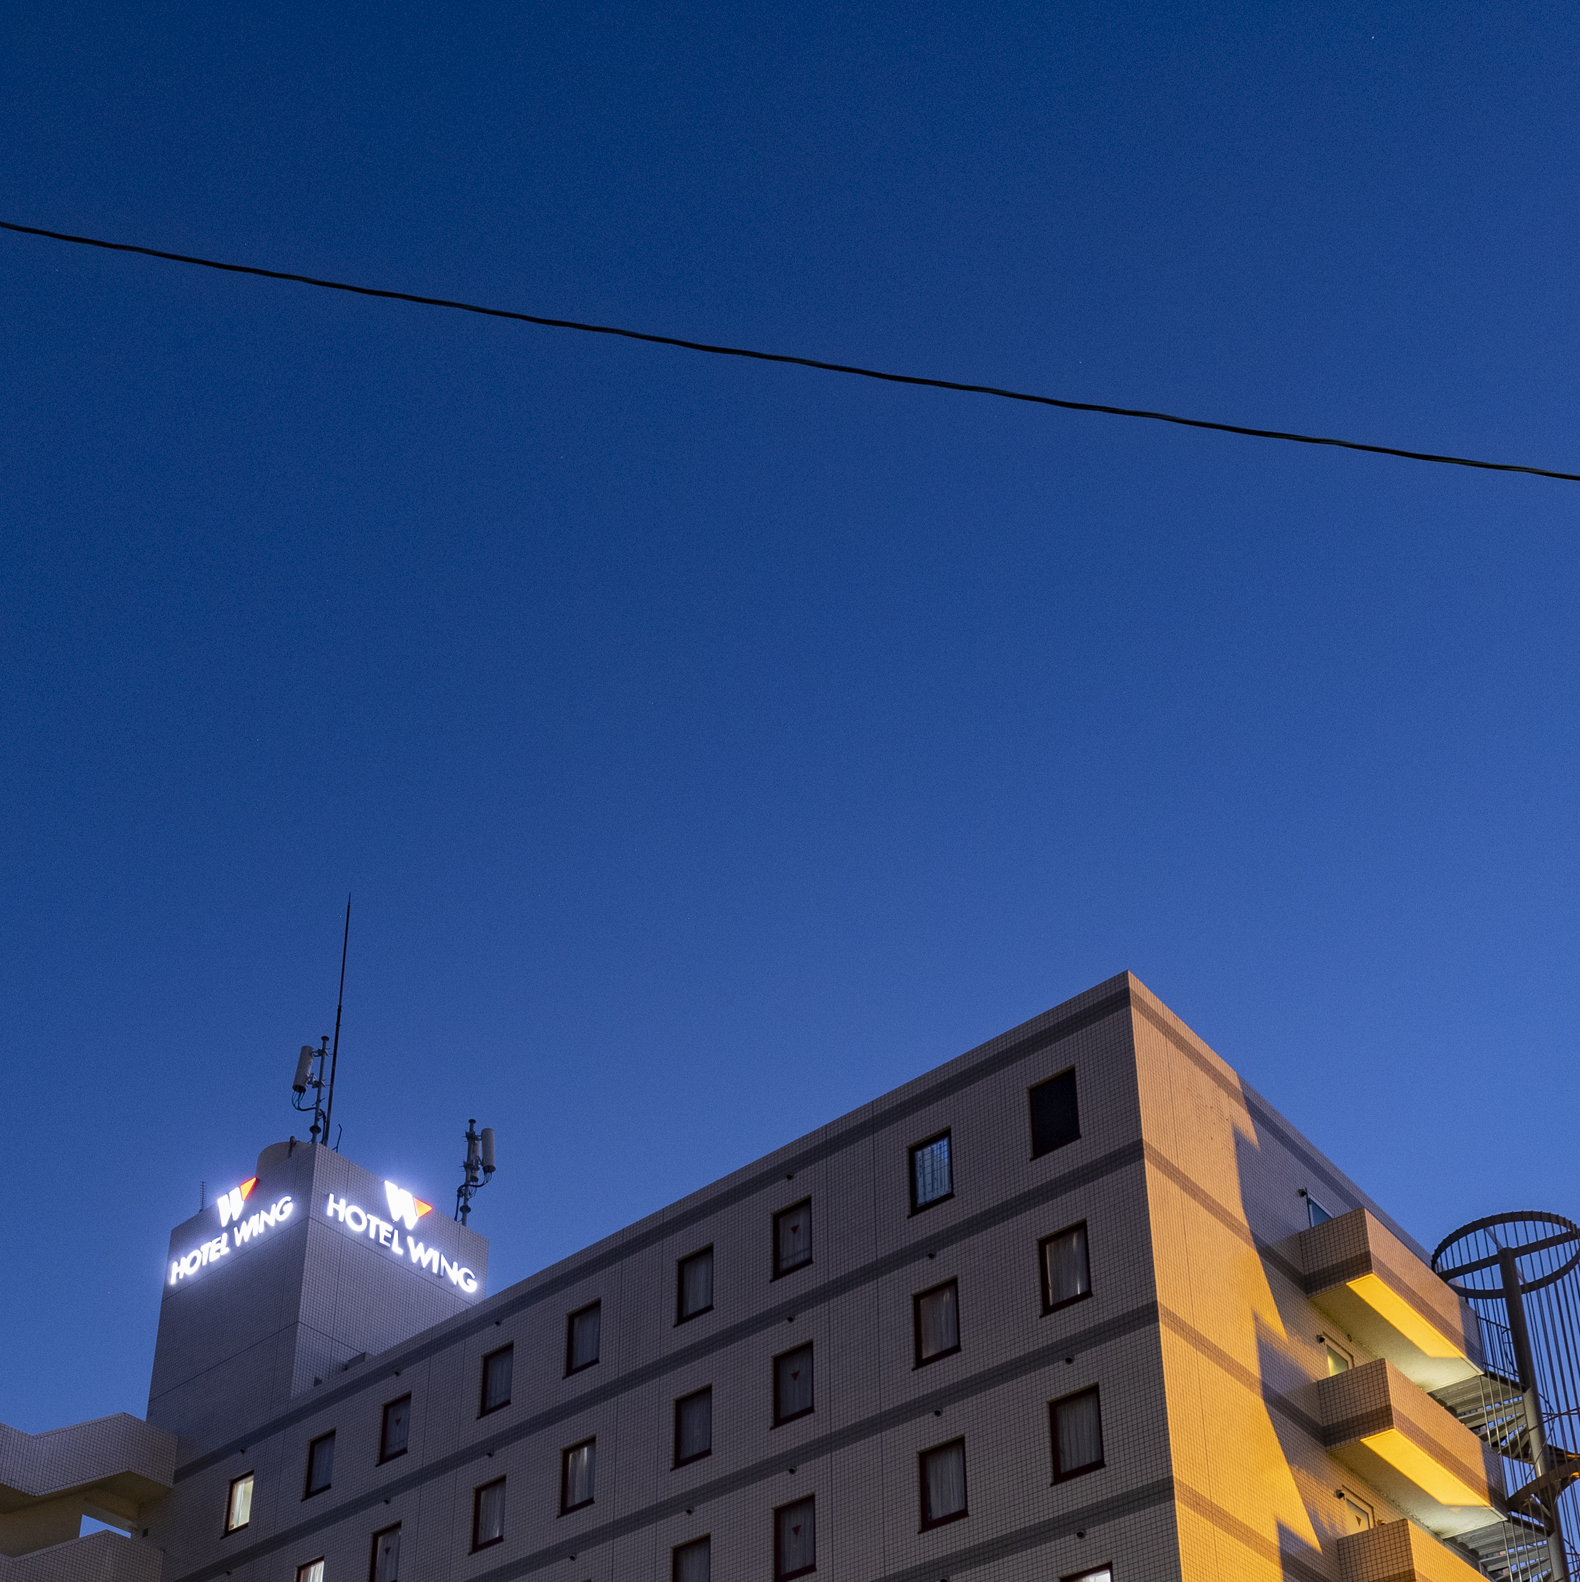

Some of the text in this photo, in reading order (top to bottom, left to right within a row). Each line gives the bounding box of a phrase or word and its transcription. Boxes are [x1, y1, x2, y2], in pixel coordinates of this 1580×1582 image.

[170, 1195, 295, 1285] HOTEL WING
[326, 1192, 478, 1294] HOTEL WING
